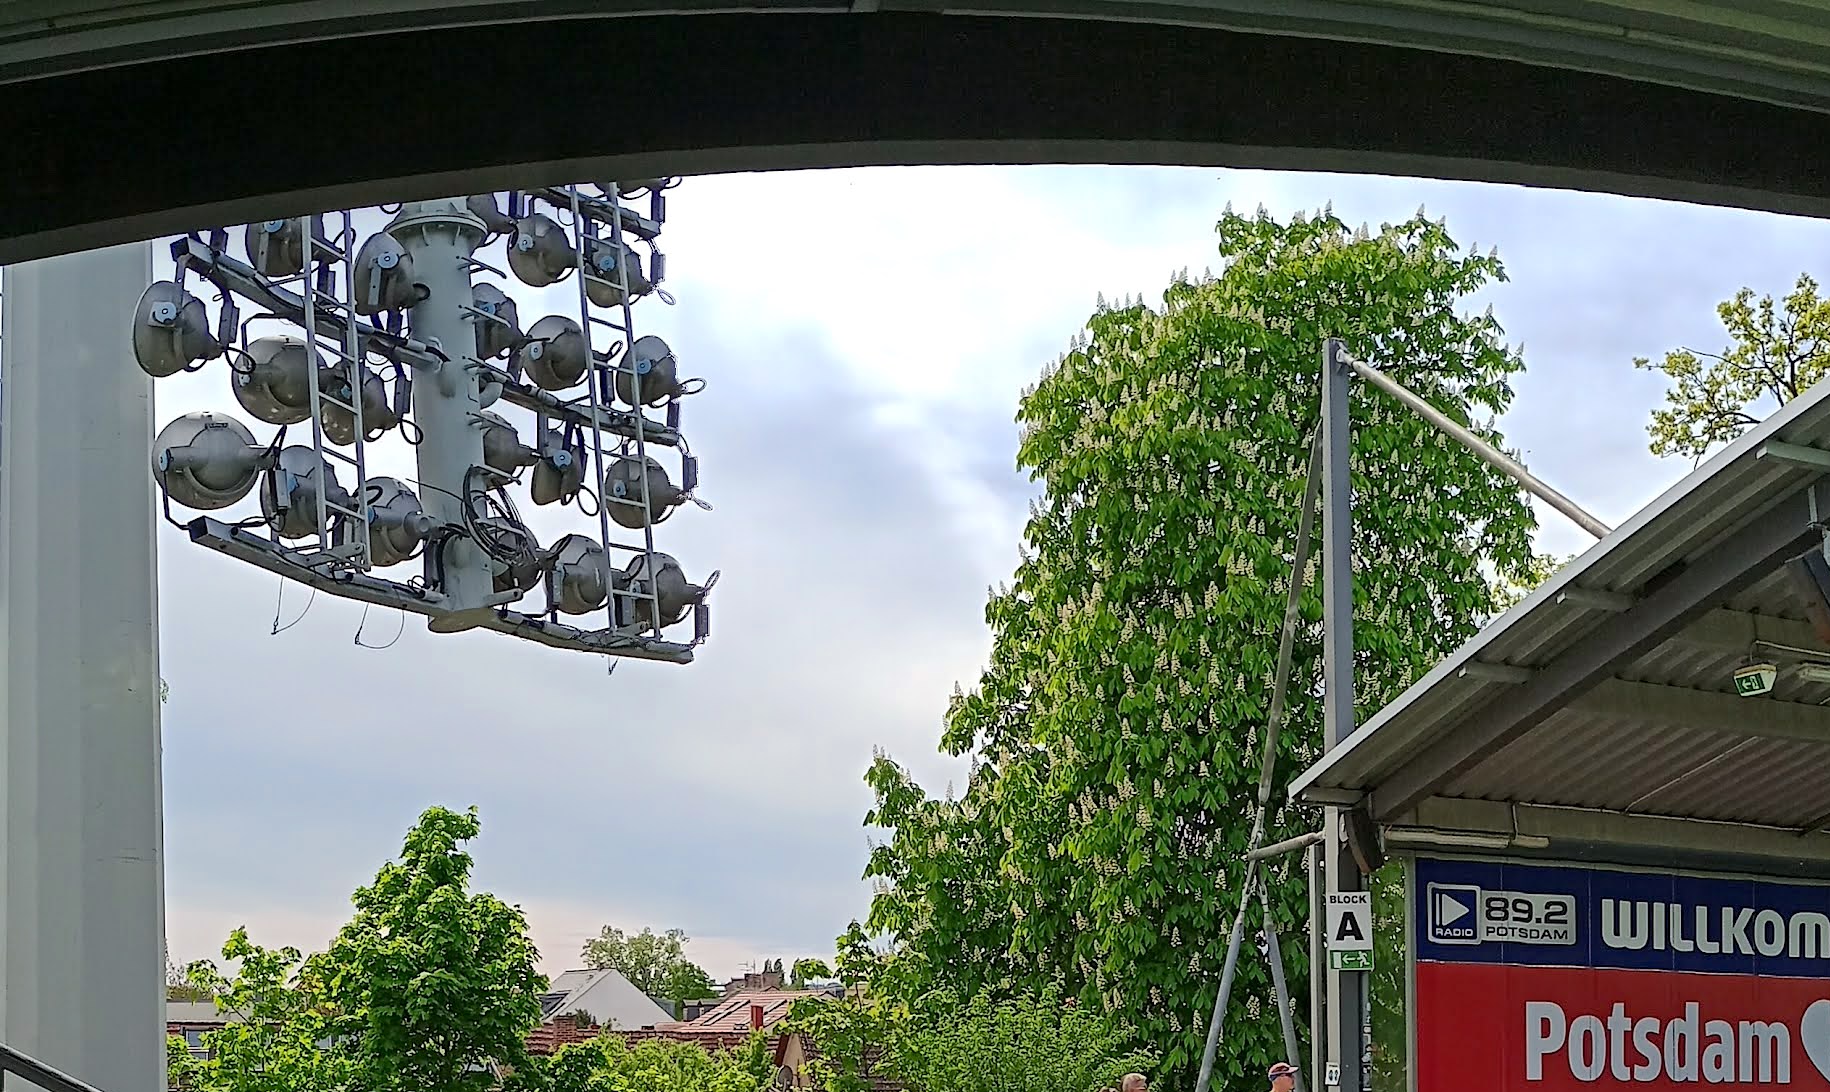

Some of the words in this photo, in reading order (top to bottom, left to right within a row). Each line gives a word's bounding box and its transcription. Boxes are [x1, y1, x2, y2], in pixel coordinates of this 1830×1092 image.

[1329, 895, 1368, 904] BLOCK
[1485, 897, 1568, 925] 89.2
[1336, 911, 1364, 941] A
[1435, 928, 1474, 937] RADIO
[1486, 926, 1568, 940] POTSDAM
[1525, 1001, 1791, 1085] Potsdam
